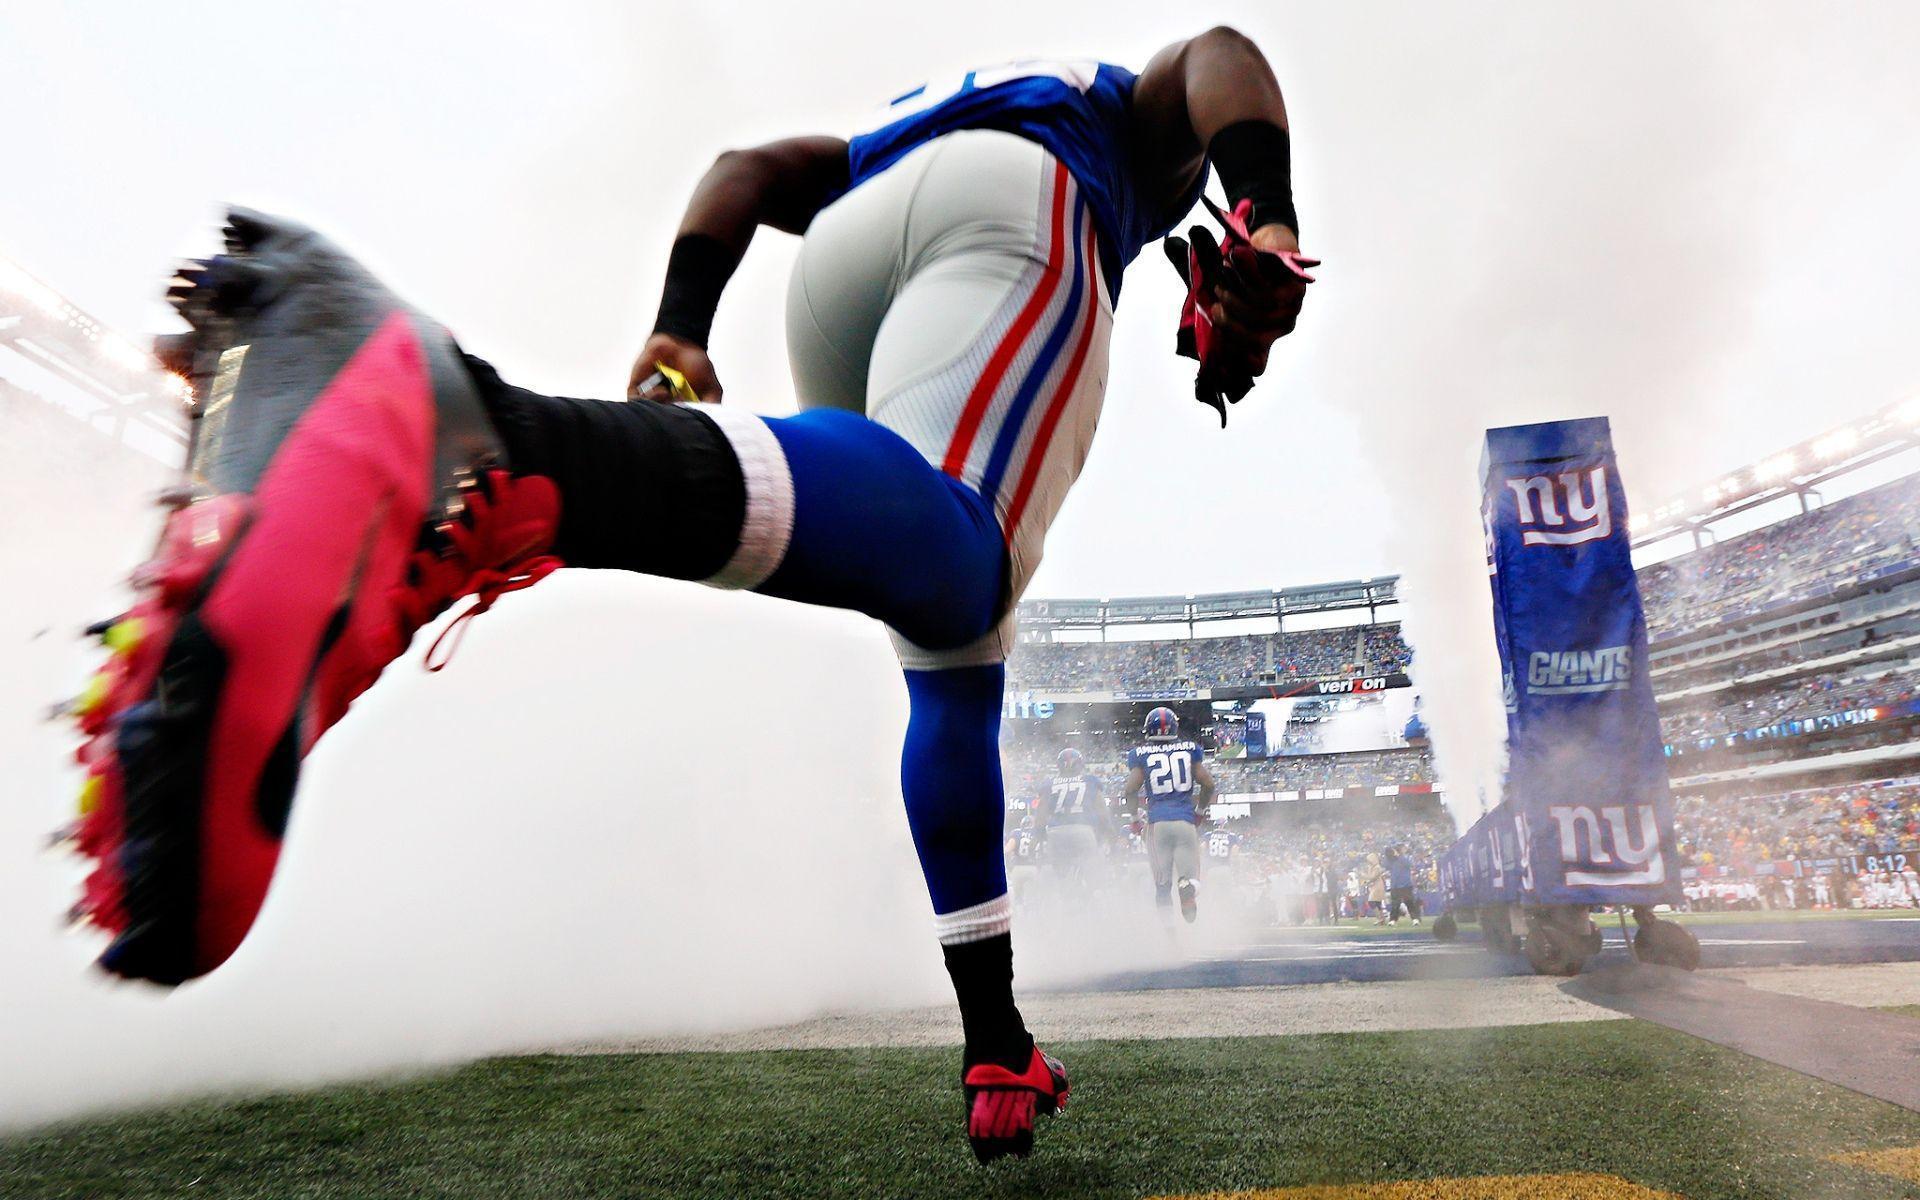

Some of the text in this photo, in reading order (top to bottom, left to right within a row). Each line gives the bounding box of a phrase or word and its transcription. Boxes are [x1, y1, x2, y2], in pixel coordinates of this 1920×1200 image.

[1505, 466, 1612, 547] ny
[1527, 645, 1632, 690] GIANTS
[1319, 677, 1386, 694] verizon
[1001, 691, 1055, 719] ife
[1136, 741, 1196, 757] AMUKAMARA
[1146, 751, 1193, 795] 20
[1051, 782, 1087, 813] 77
[1209, 839, 1229, 857] 86
[1549, 805, 1665, 887] ny
[1866, 854, 1907, 873] 8:12
